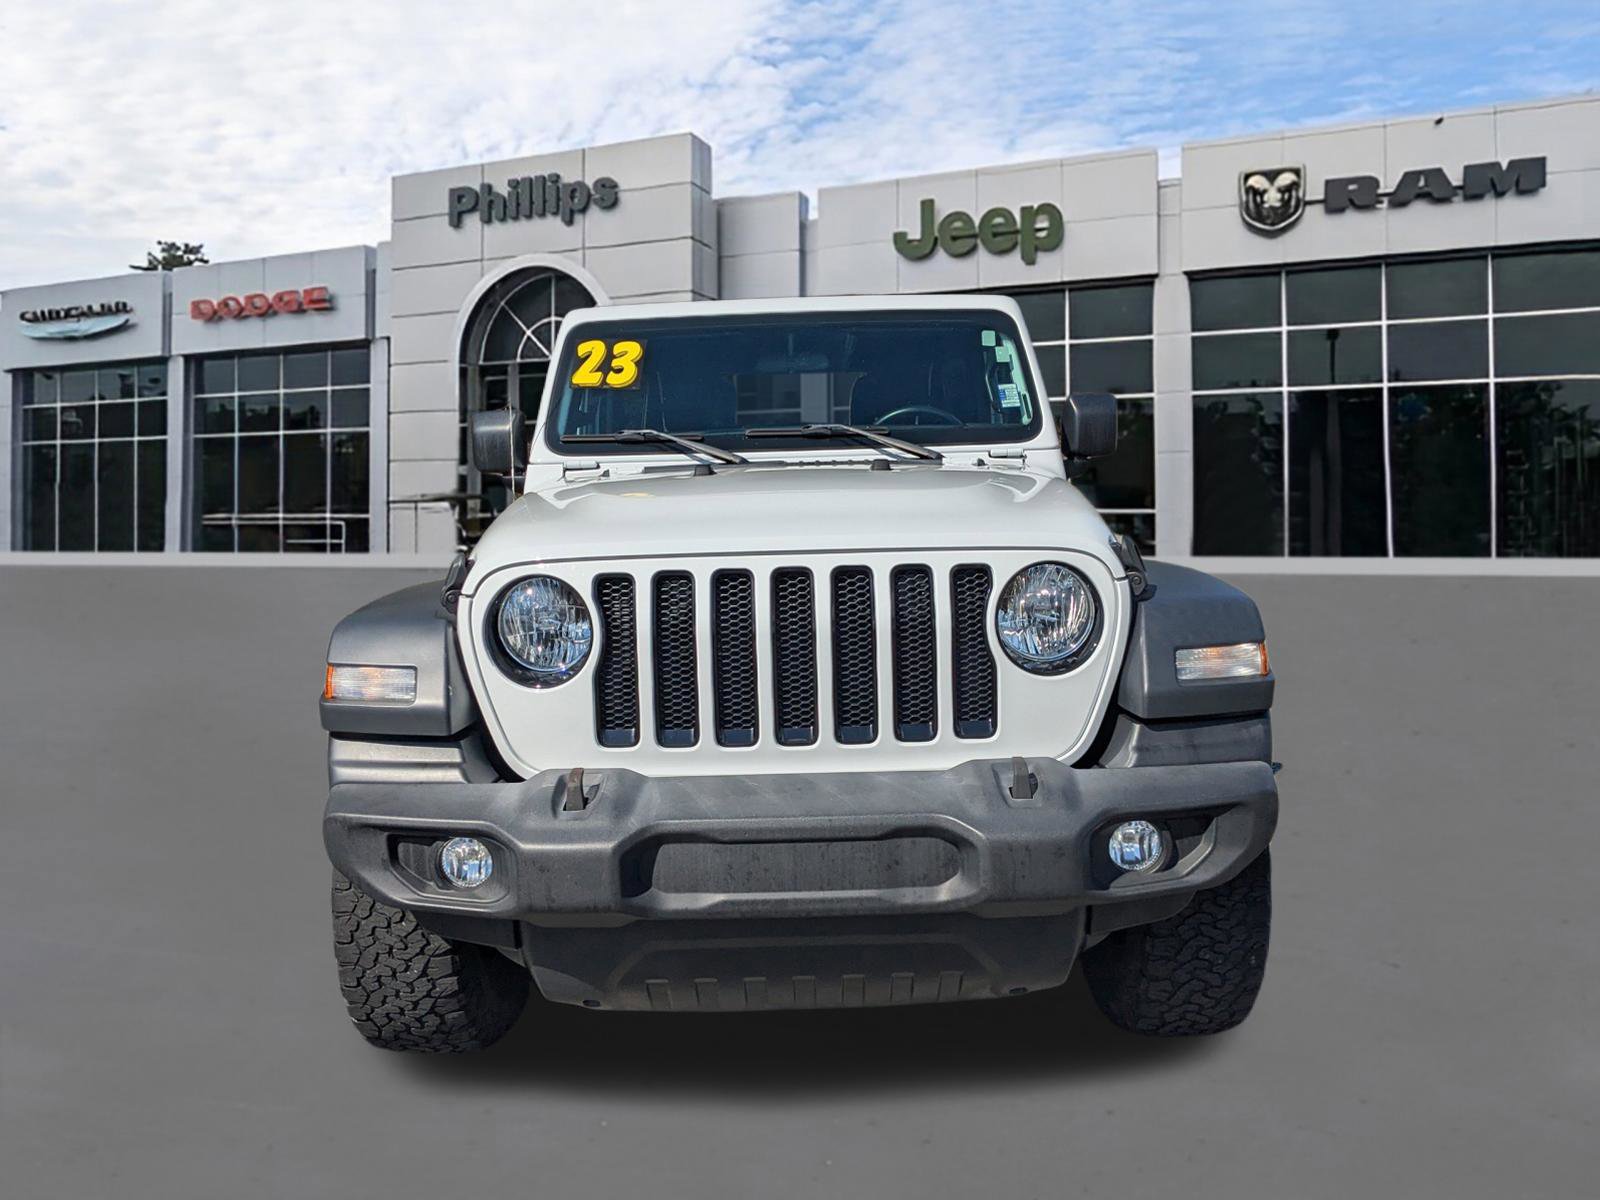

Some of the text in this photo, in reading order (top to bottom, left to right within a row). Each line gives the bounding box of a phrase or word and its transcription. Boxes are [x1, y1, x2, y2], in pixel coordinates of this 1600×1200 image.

[449, 173, 619, 227] Phillips
[1325, 157, 1546, 214] RAM
[893, 198, 1064, 266] Jeep
[191, 287, 332, 321] DODGE
[571, 339, 643, 388] 23
